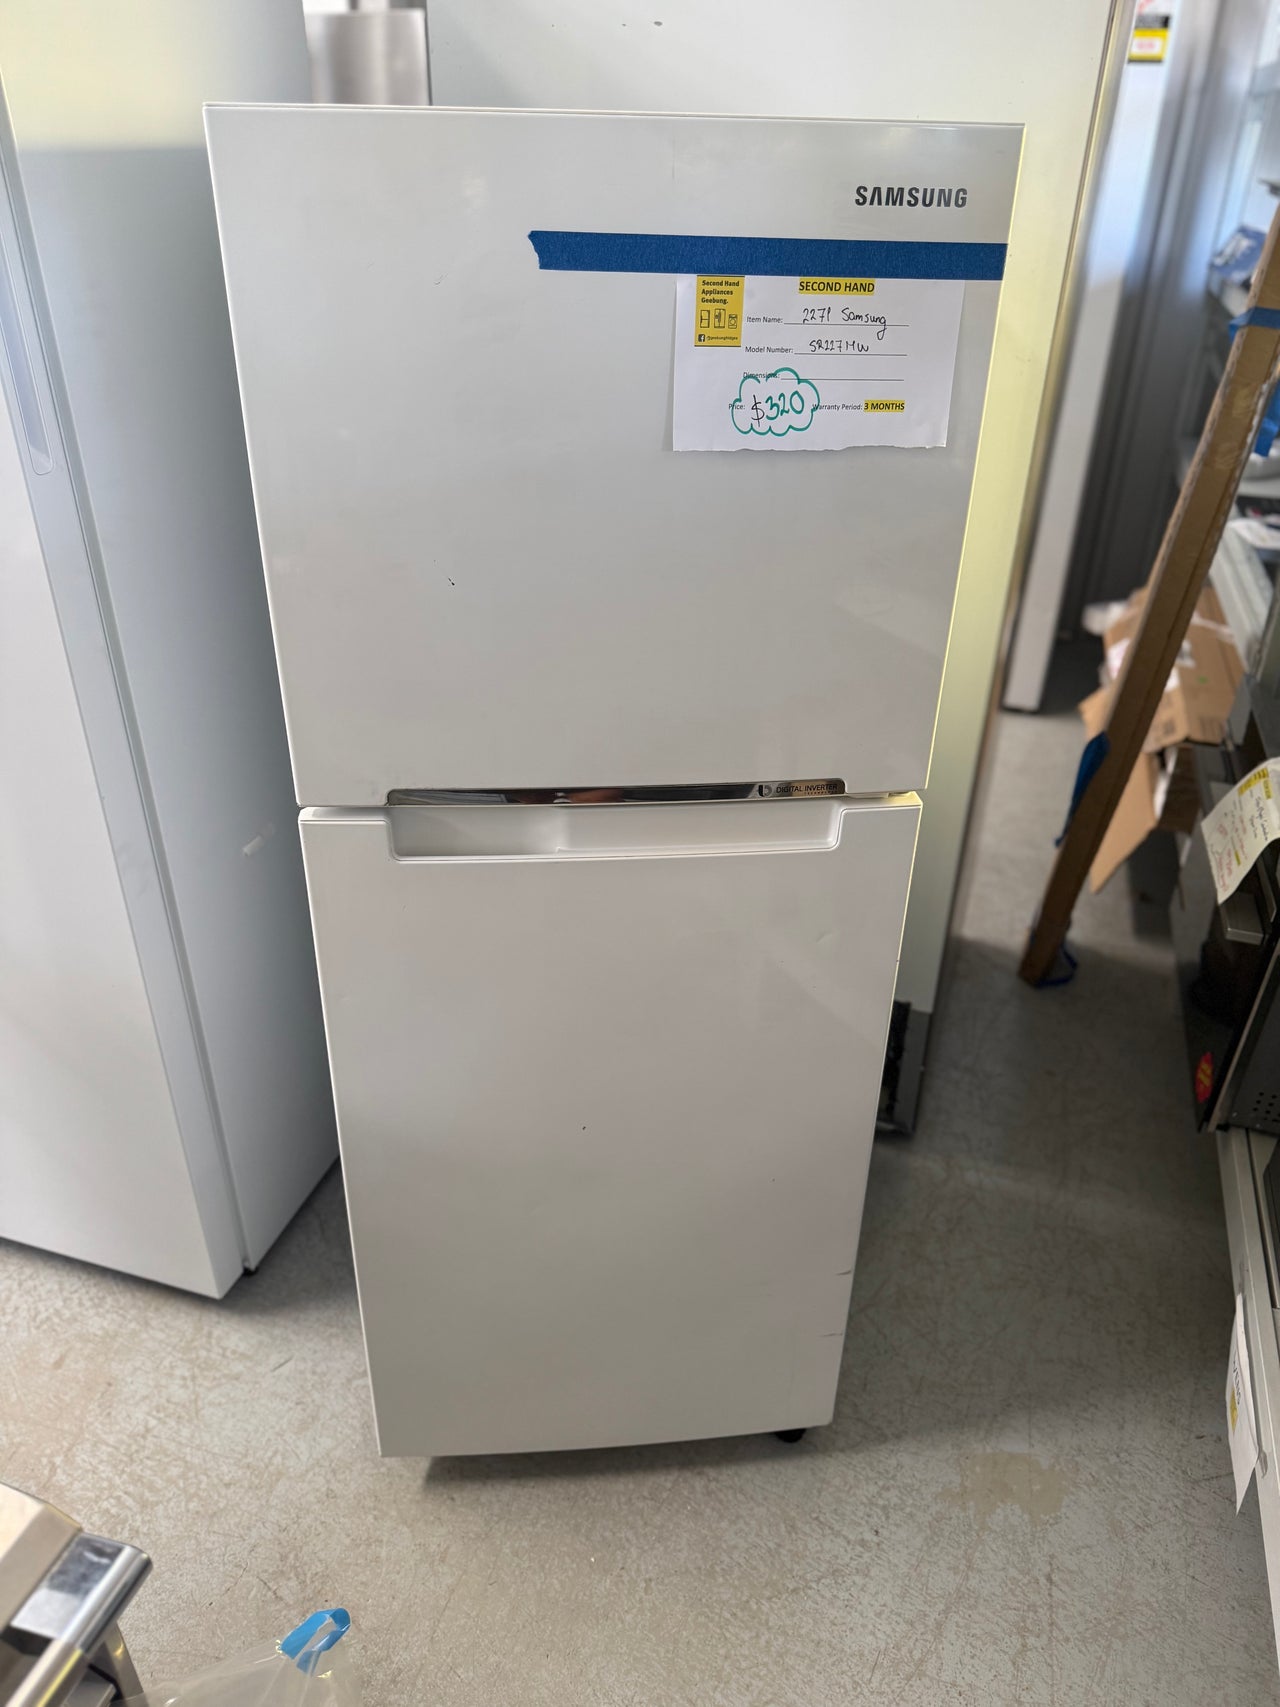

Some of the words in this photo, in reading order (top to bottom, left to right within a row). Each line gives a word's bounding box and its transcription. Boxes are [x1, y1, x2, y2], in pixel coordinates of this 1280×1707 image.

[855, 185, 968, 208] SAMSUNG
[798, 281, 841, 292] SECOND
[844, 282, 875, 293] HAND
[701, 288, 734, 296] Appliances
[701, 297, 729, 305] Geebung.
[762, 316, 784, 324] Name:
[841, 307, 888, 341] Samsung
[766, 346, 794, 354] Number:
[750, 390, 805, 427] $320
[812, 403, 840, 411] Warranty
[841, 403, 863, 411] Period:
[863, 402, 869, 410] 3
[870, 402, 905, 411] MONTHS
[775, 785, 803, 793] DIGITAL
